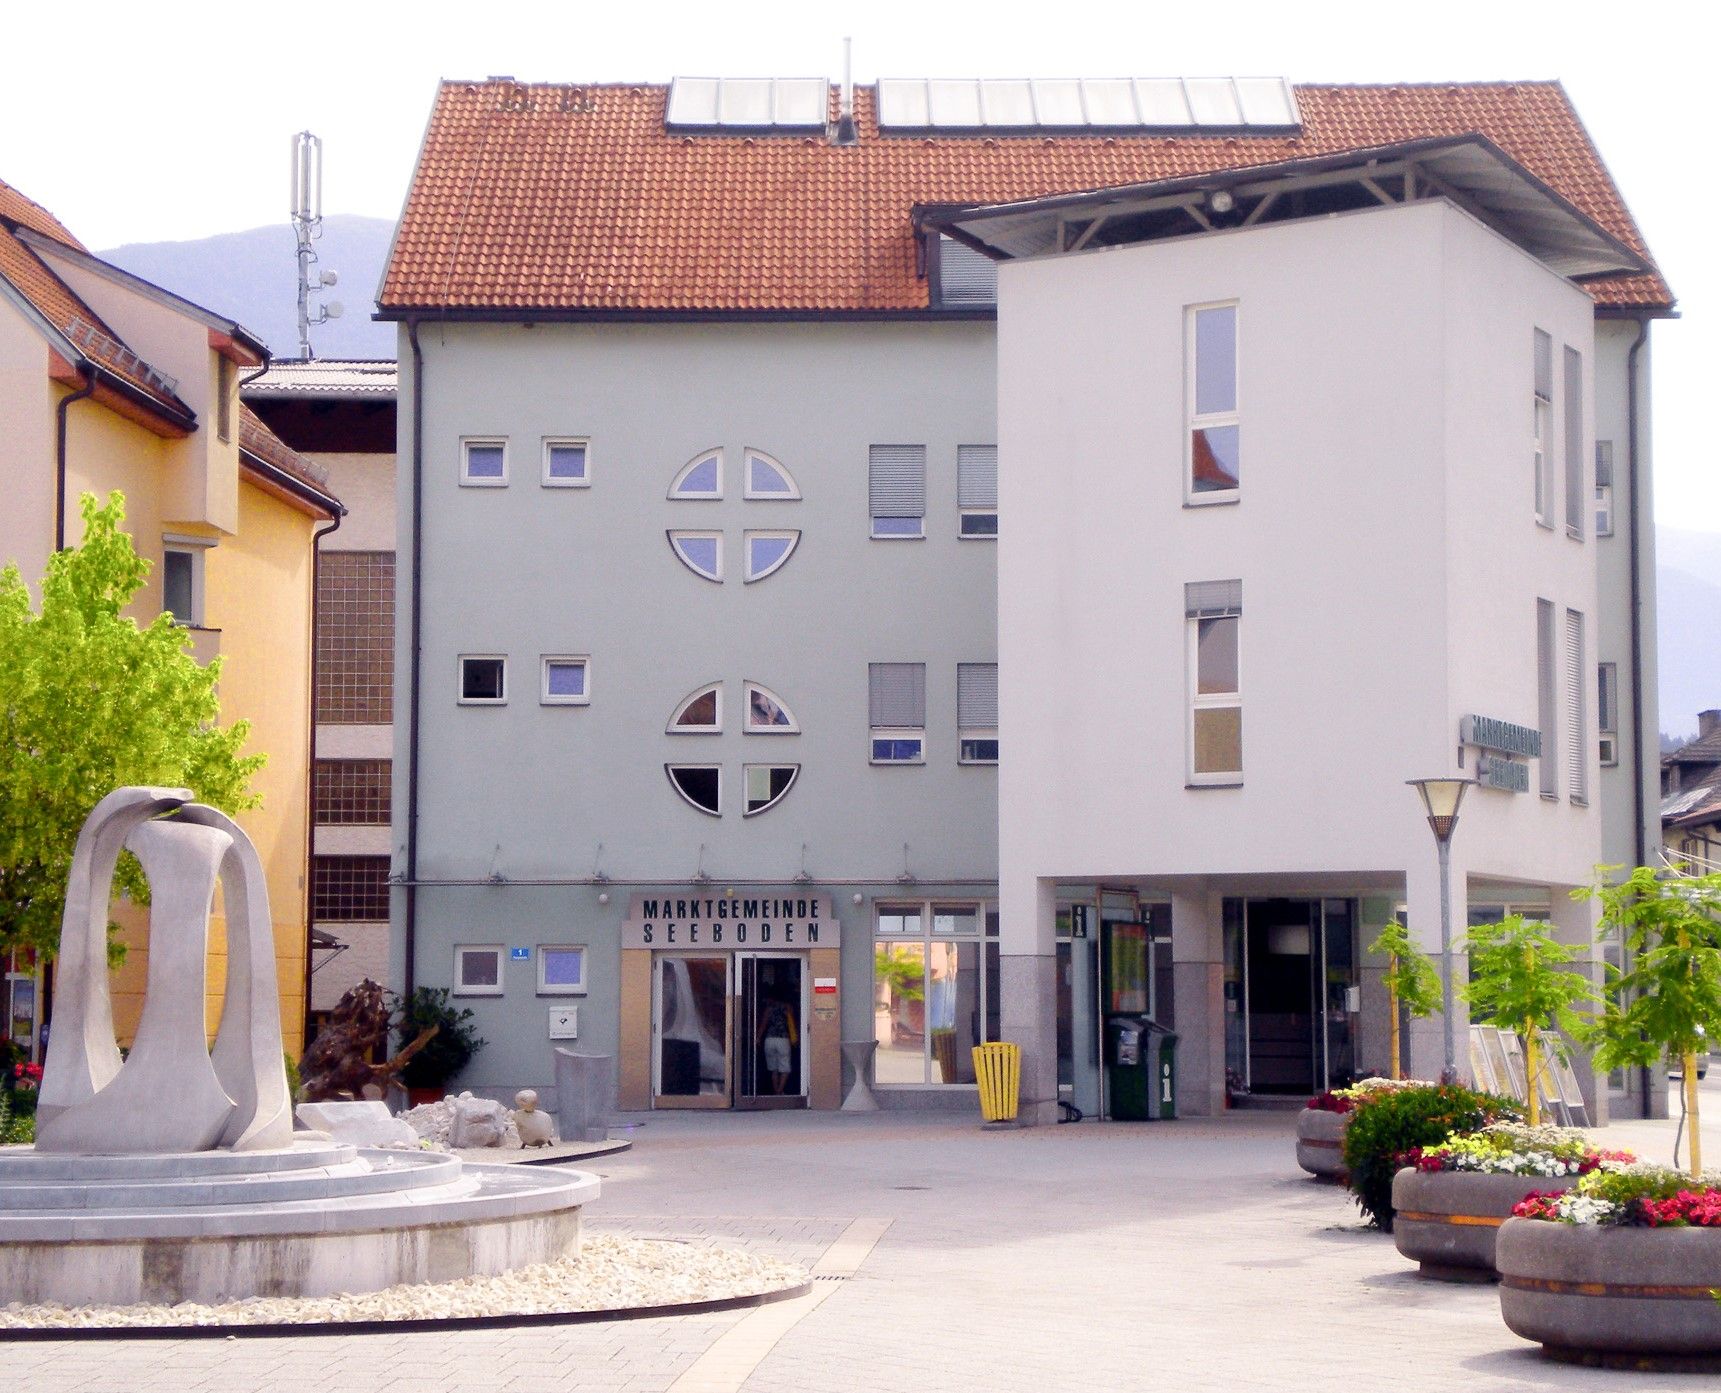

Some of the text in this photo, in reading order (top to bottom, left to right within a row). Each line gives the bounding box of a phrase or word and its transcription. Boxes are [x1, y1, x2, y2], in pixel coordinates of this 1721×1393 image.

[643, 899, 819, 919] MARKTGEMEINDE
[643, 923, 819, 943] SEEBODEN
[1162, 1063, 1172, 1102] i
